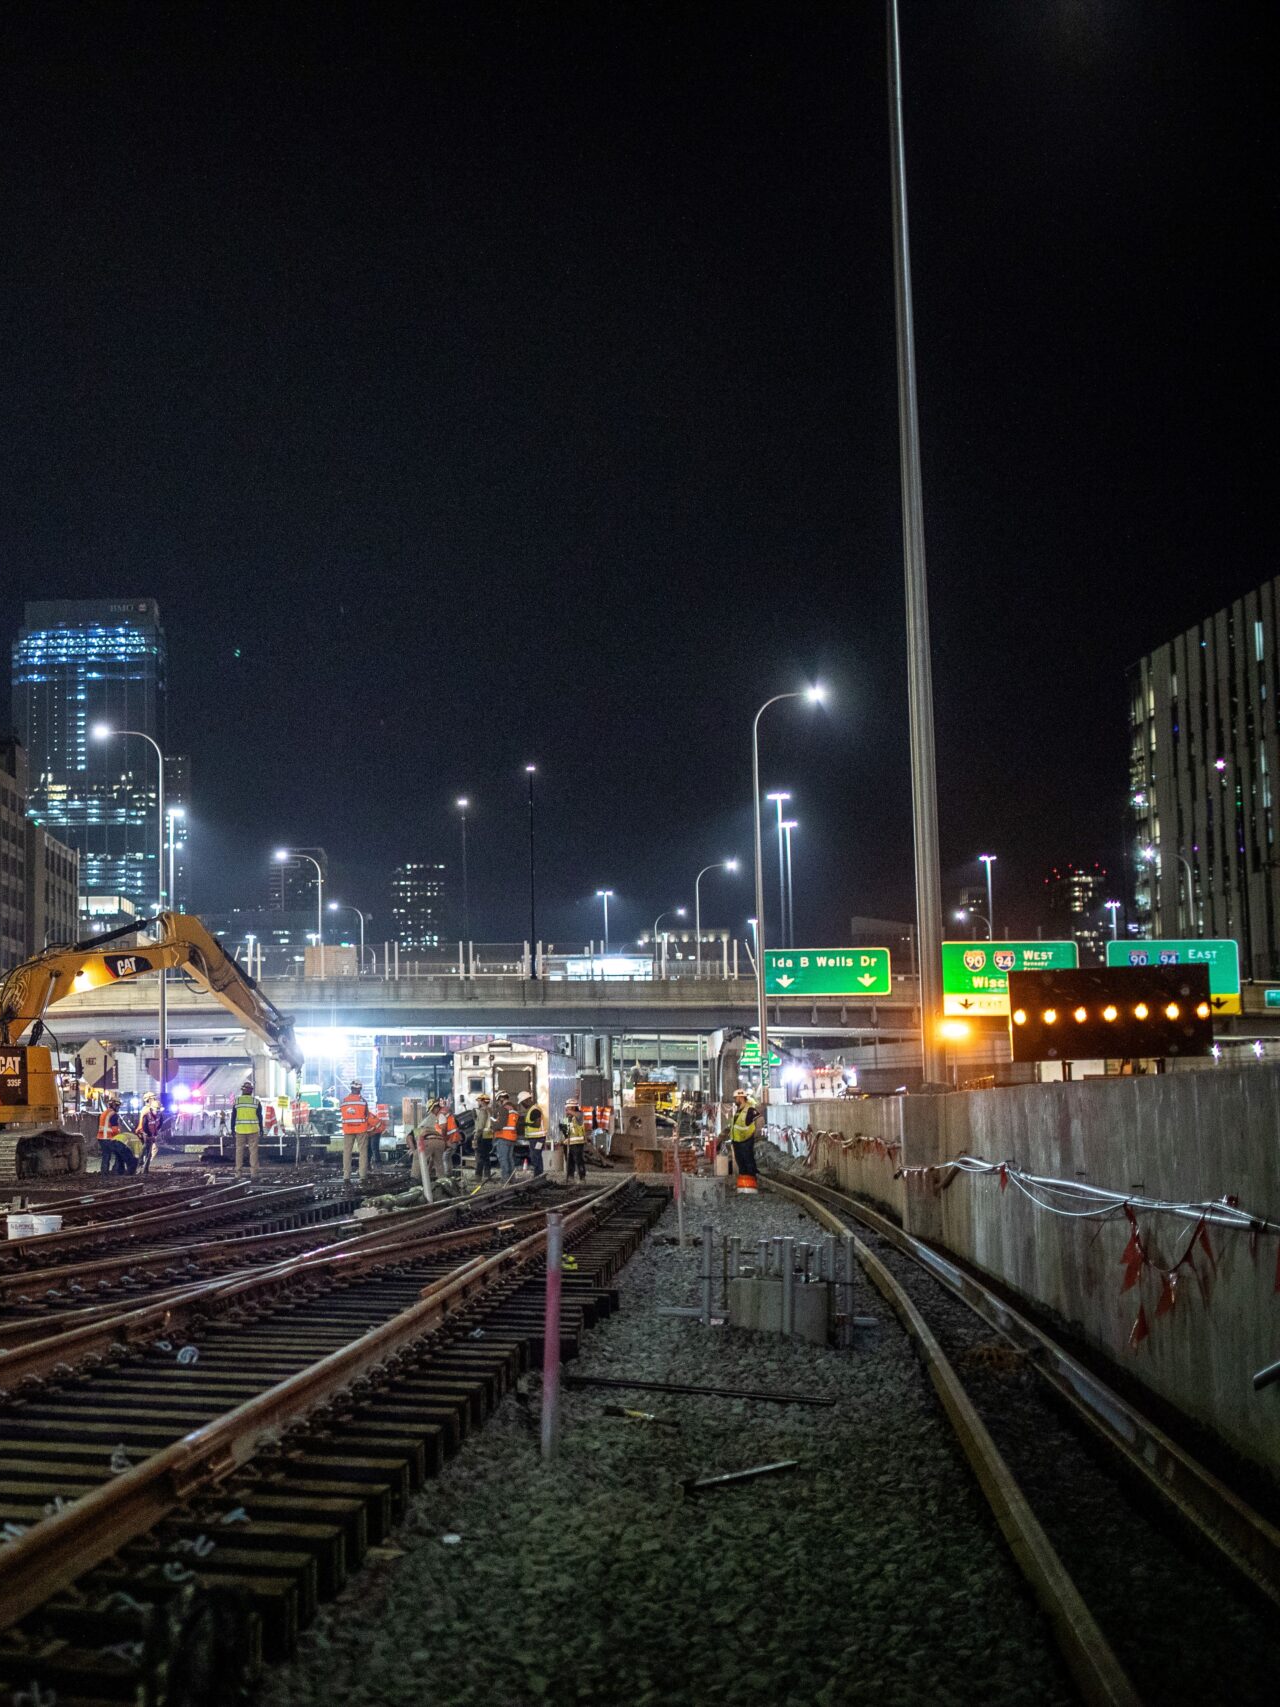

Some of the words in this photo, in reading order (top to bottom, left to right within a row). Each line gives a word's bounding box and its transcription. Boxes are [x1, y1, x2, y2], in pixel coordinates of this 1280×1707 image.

[772, 957, 793, 968] Ida
[800, 956, 809, 967] B
[816, 956, 853, 967] Wells
[860, 955, 877, 967] Dr
[966, 957, 983, 967] 90
[996, 956, 1013, 967] 94
[1023, 950, 1053, 960] WEST
[1130, 955, 1147, 965] 90
[1160, 954, 1177, 964] 94
[1188, 949, 1217, 959] EAST
[117, 957, 136, 976] CAT
[7, 1079, 21, 1087] 335F
